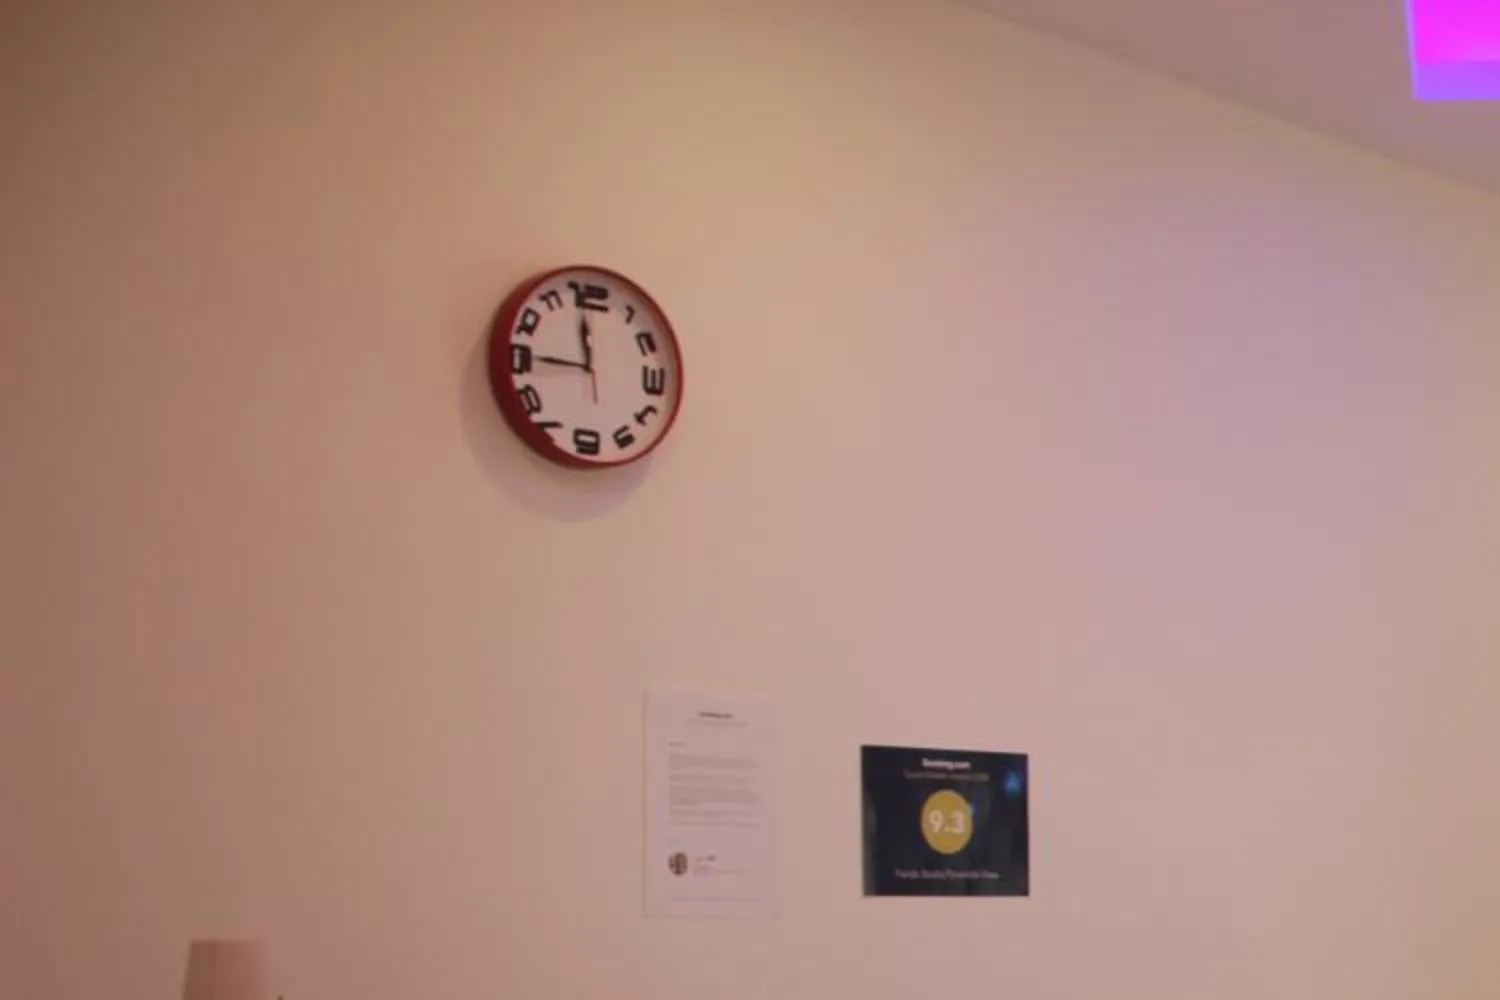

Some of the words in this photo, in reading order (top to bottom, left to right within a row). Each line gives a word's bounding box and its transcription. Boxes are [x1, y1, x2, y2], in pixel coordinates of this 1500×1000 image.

[567, 281, 609, 313] 12
[625, 304, 636, 325] 1
[636, 332, 656, 356] 2
[642, 364, 665, 396] 3
[633, 404, 657, 427] 4
[573, 428, 600, 455] 6
[612, 425, 635, 450] 5
